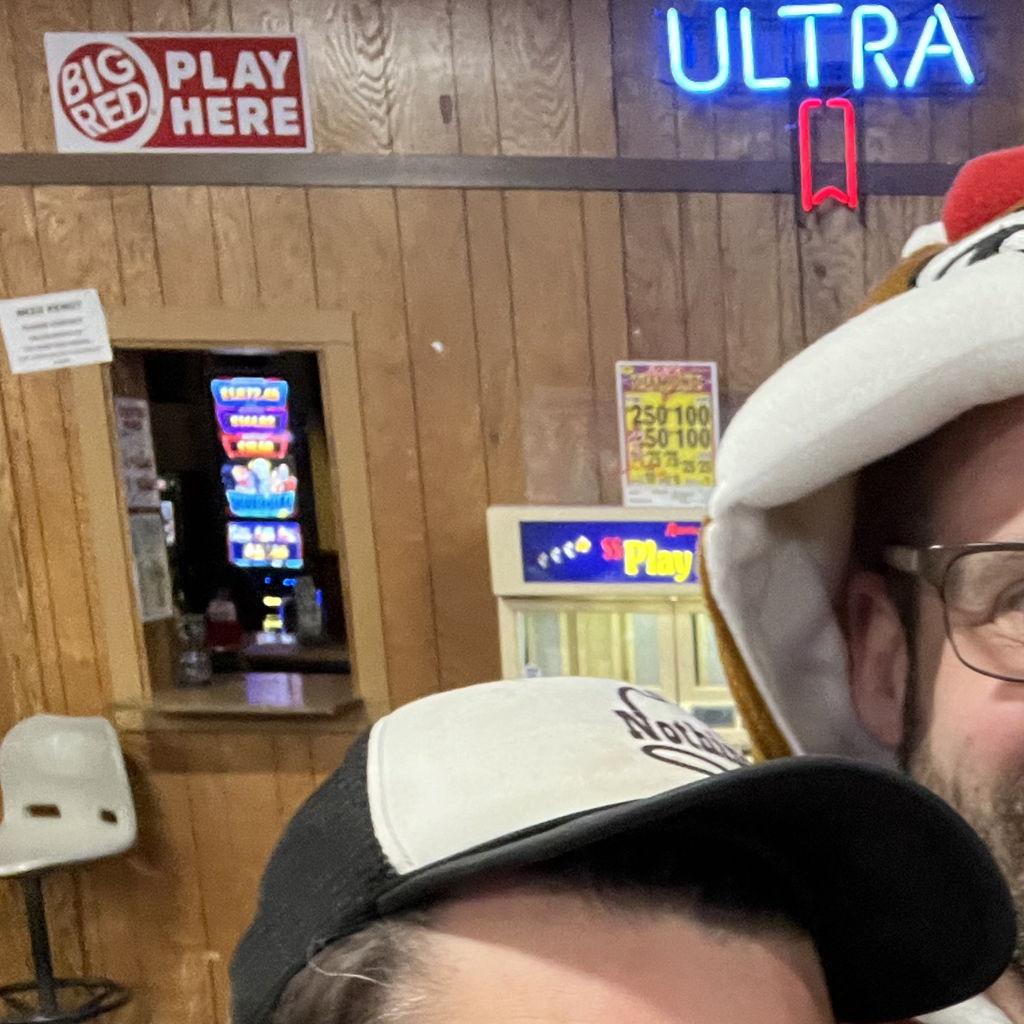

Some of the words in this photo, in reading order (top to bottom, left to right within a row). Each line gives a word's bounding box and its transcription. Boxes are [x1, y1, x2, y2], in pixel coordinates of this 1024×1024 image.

[667, 3, 975, 92] ULTRA
[61, 46, 137, 106] BIG
[165, 50, 293, 90] PLAY
[69, 82, 149, 138] RED
[169, 96, 300, 135] HERE
[633, 404, 668, 426] 250
[676, 404, 710, 427] 100
[676, 429, 711, 449] 100
[623, 538, 693, 583] Play
